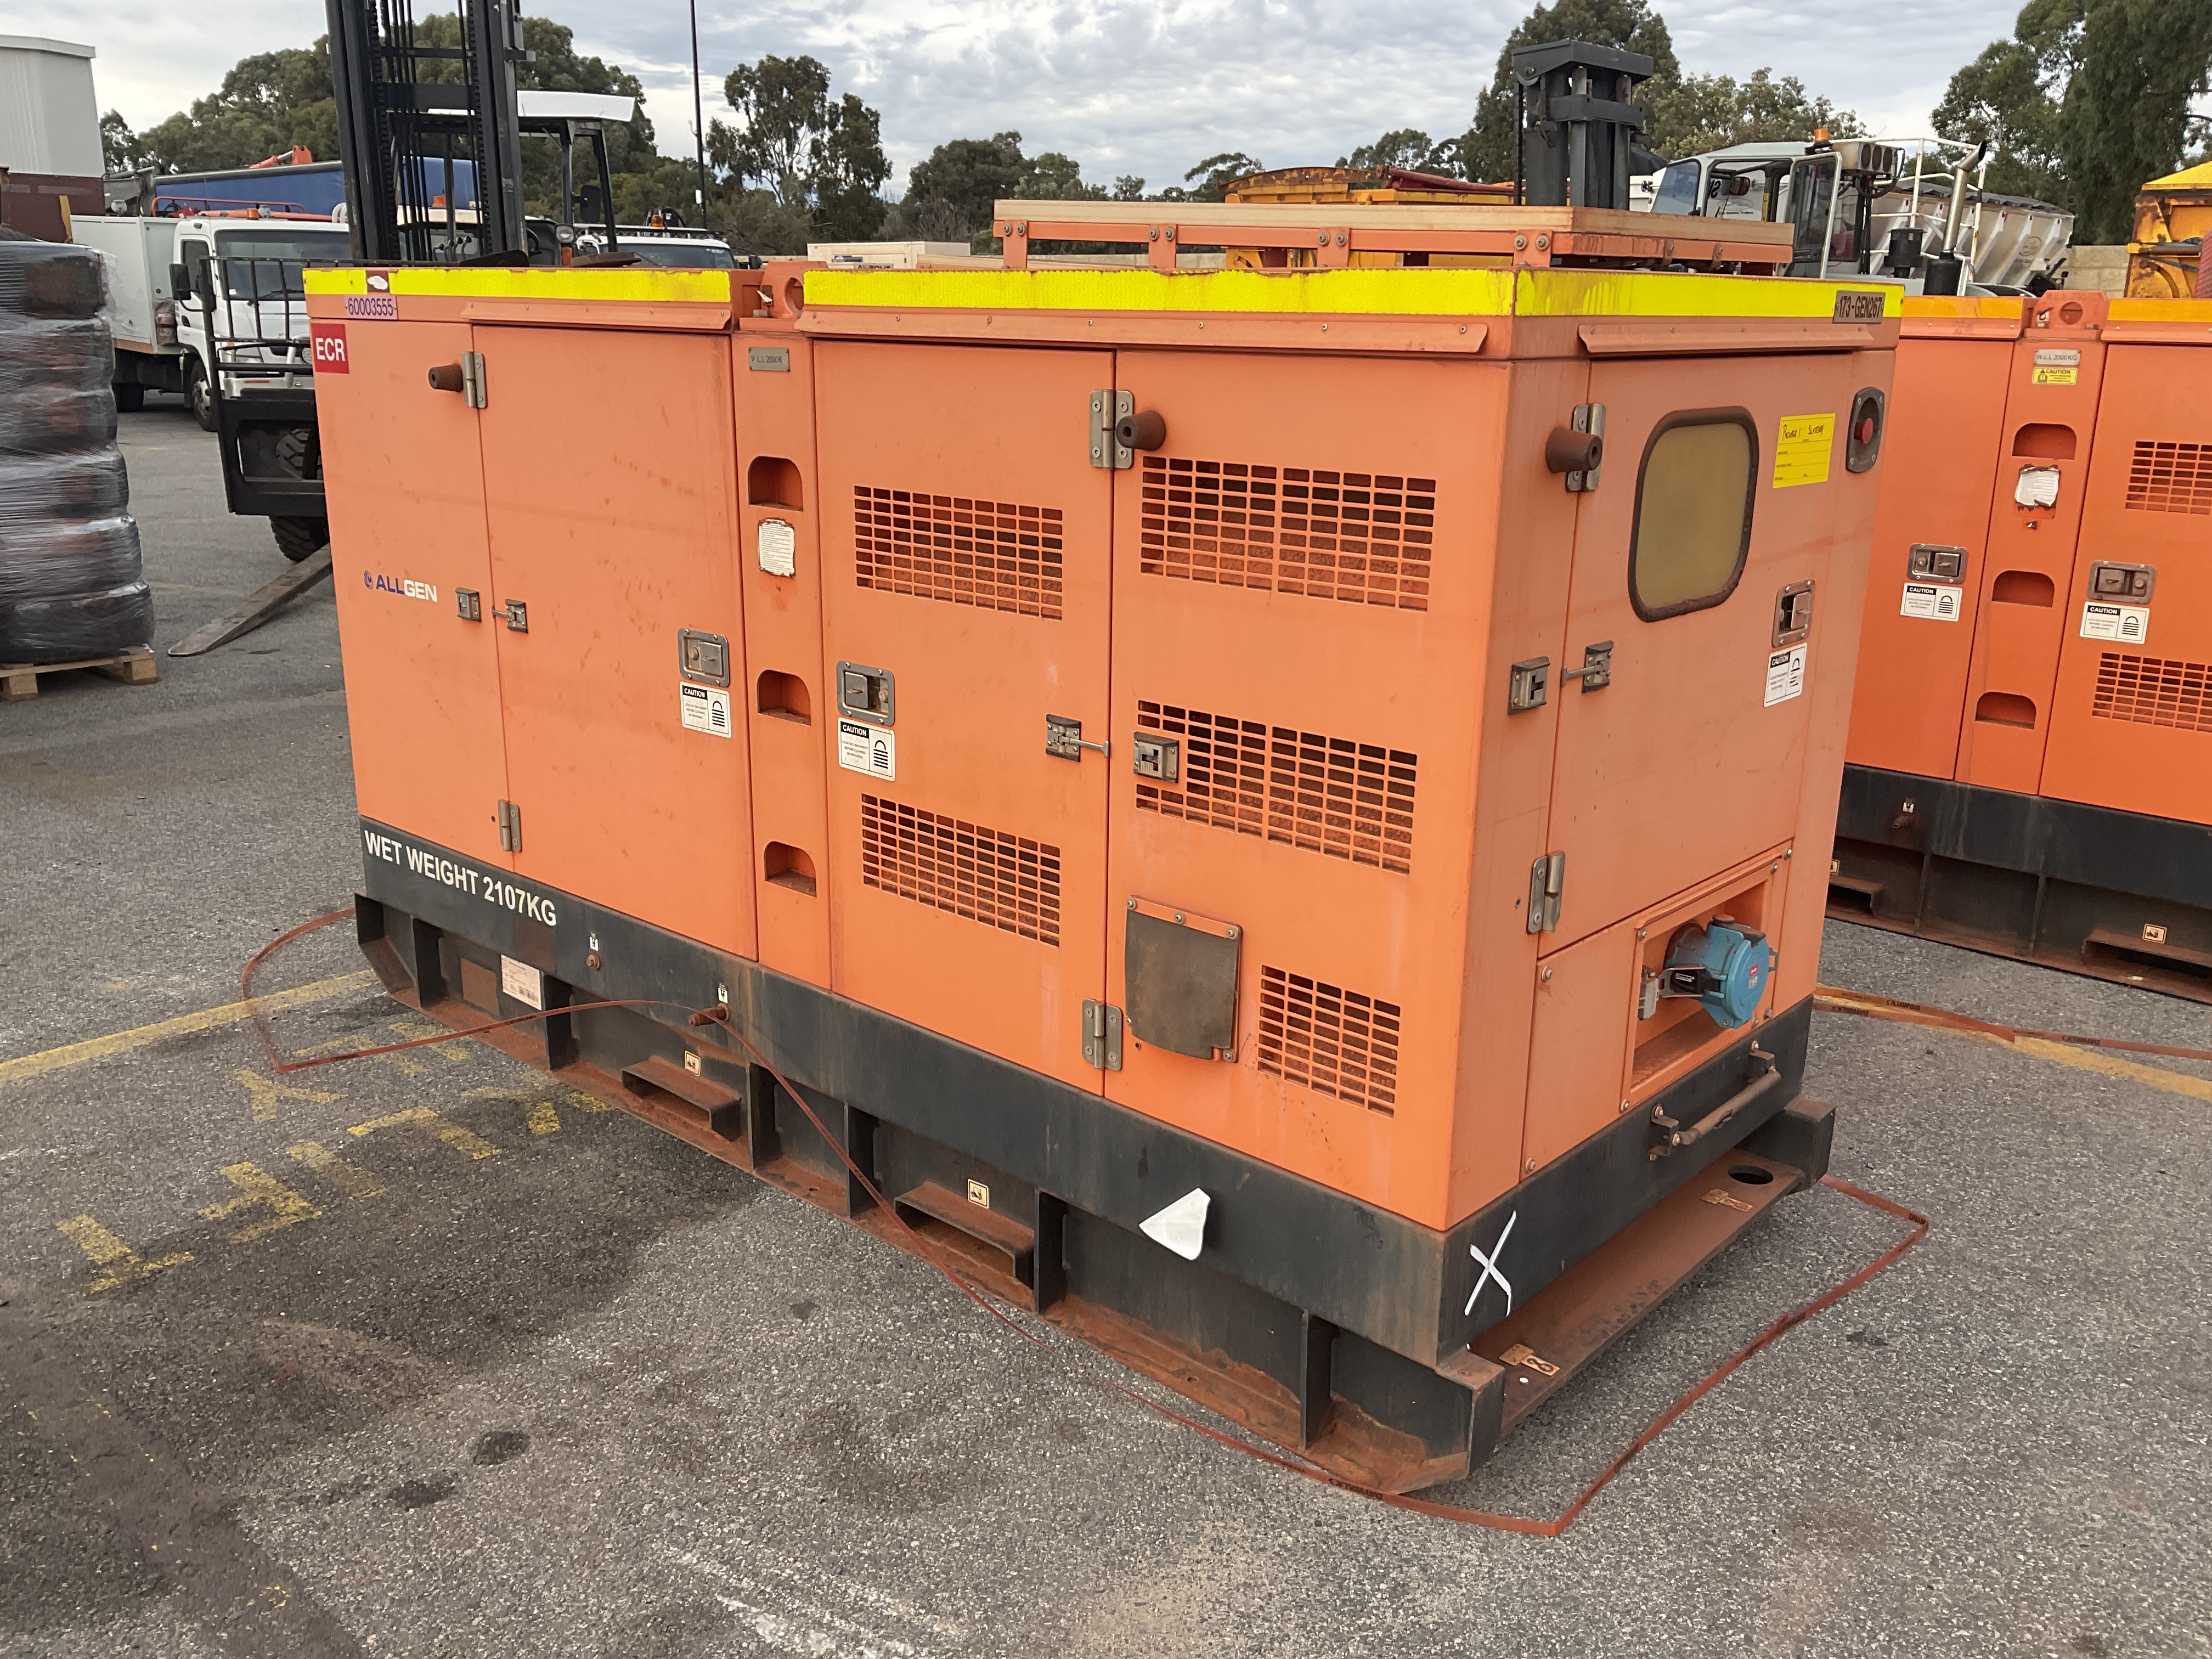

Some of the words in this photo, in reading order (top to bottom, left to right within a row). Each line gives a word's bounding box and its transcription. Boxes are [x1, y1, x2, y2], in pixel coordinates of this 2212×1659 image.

[348, 298, 394, 317] 60003555
[315, 337, 346, 362] ECR
[376, 574, 438, 602] ALLGEN
[1771, 654, 1789, 666] CAUTION
[684, 687, 706, 698] CAUTION
[842, 724, 867, 736] CAUTION
[364, 830, 402, 865] WET
[405, 845, 478, 895] WEIGHT
[483, 876, 557, 926] 2107KG
